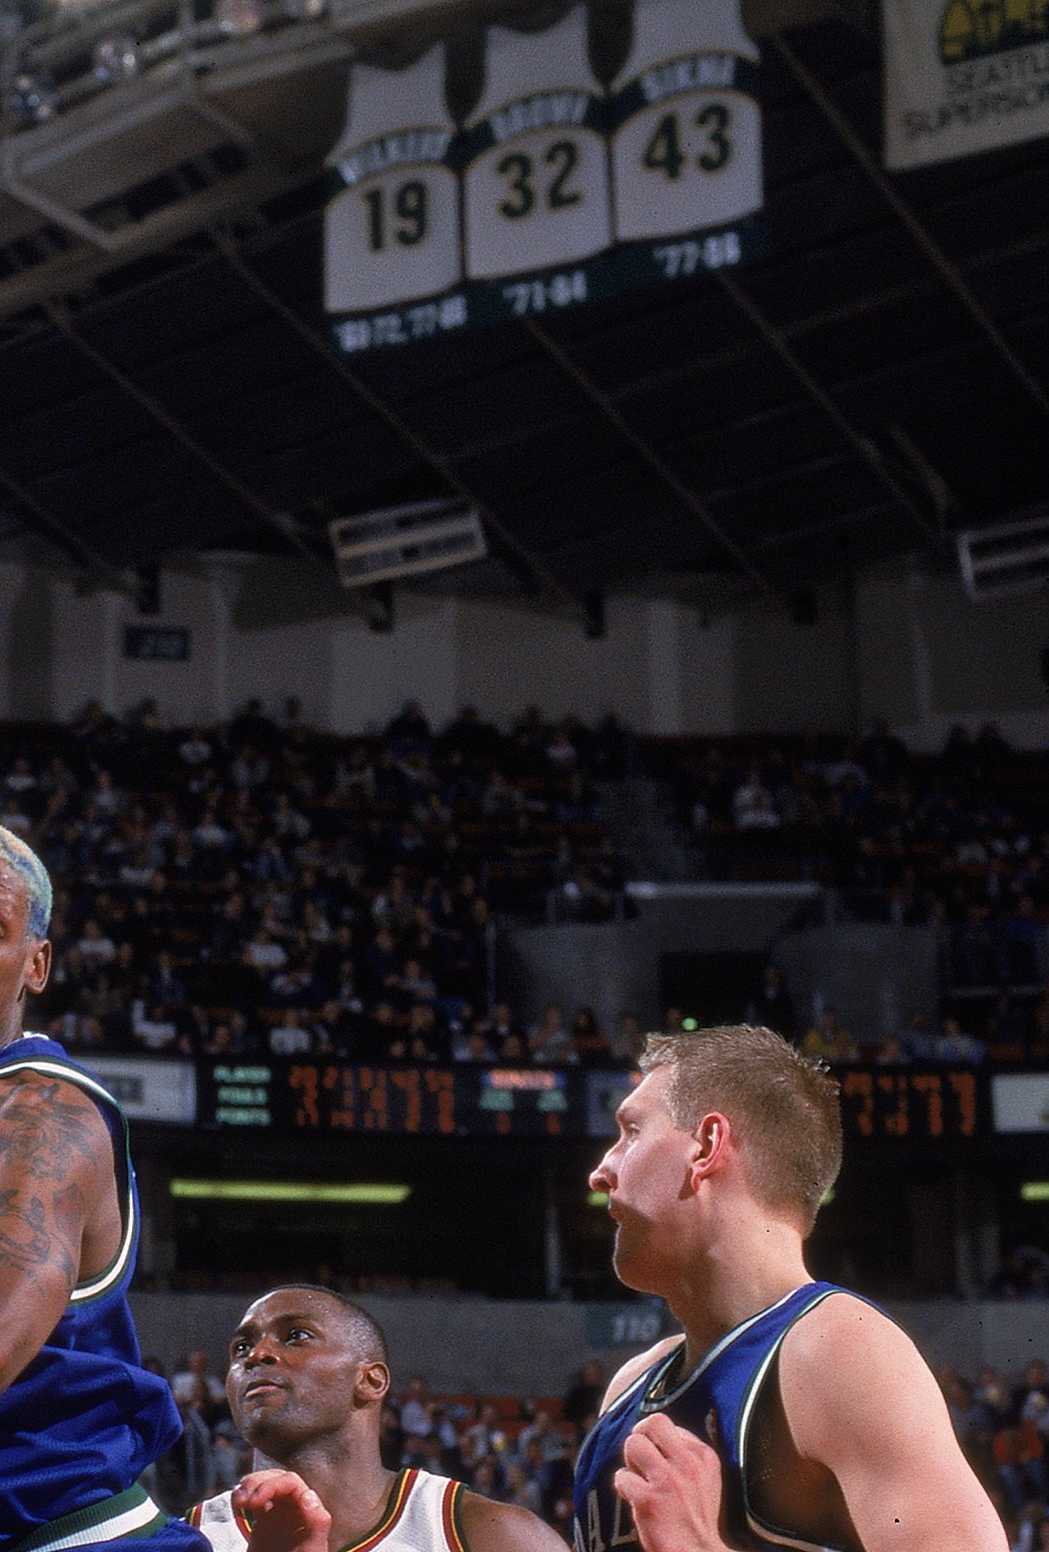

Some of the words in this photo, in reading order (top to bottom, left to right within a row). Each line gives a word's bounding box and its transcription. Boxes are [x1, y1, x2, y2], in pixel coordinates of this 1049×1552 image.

[645, 104, 730, 179] 43
[366, 180, 427, 253] 19
[499, 142, 580, 218] 32
